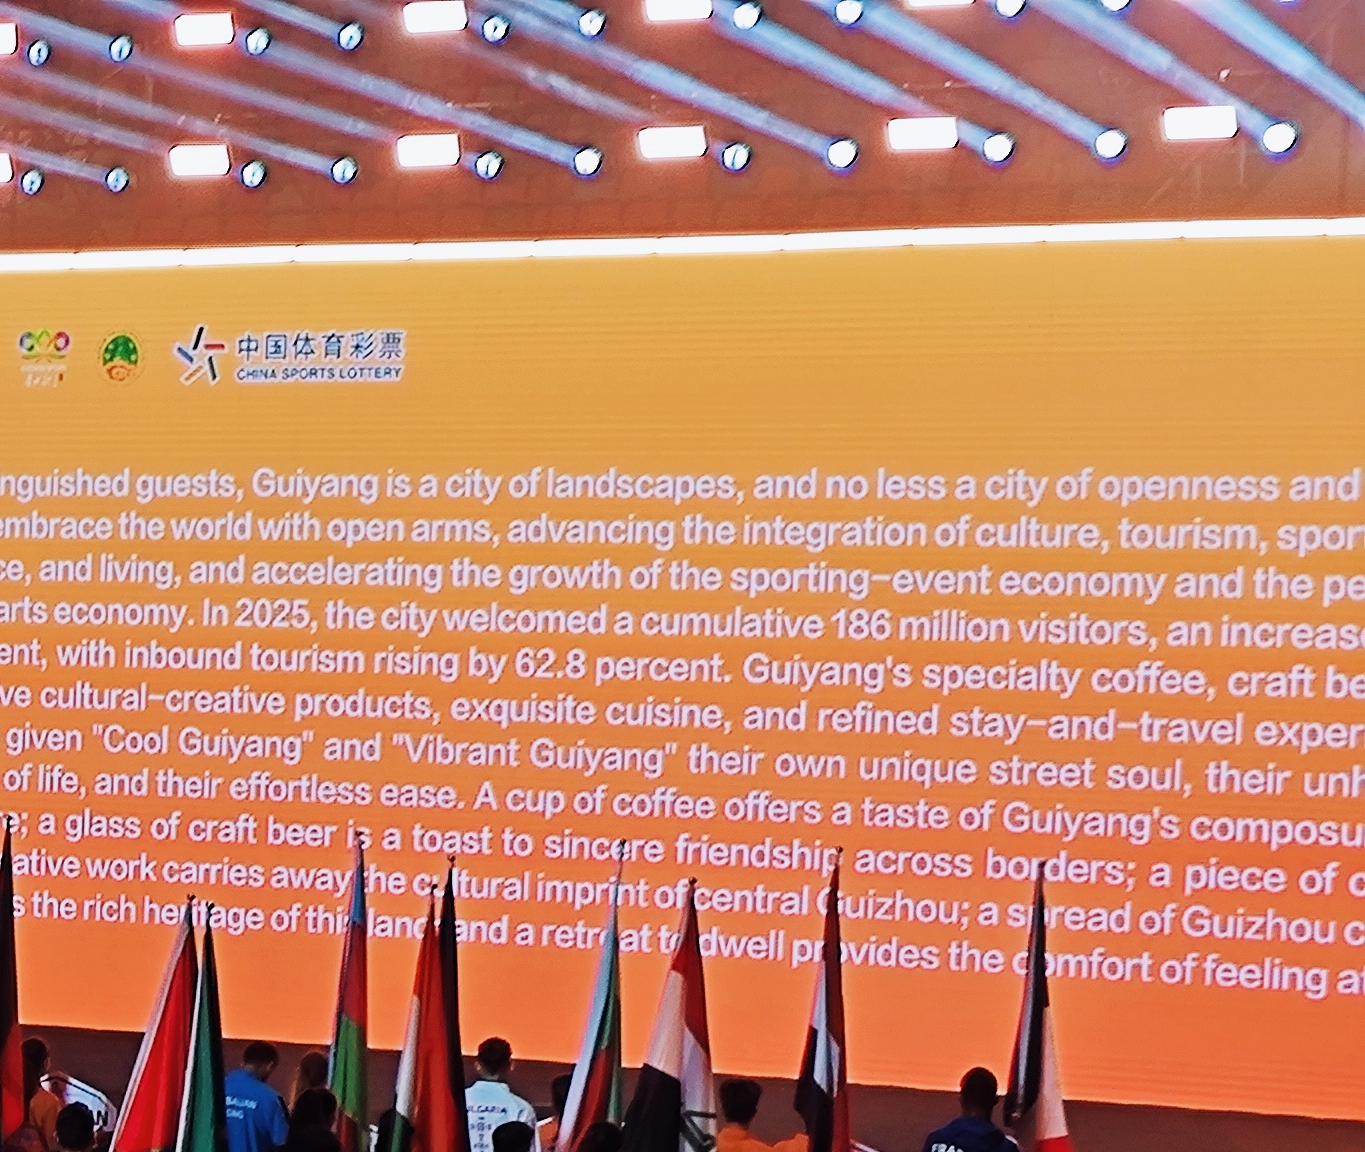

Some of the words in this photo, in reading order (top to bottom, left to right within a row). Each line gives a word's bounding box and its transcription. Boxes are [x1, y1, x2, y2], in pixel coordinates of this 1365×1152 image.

[236, 331, 404, 361] 中国体育彩票
[236, 367, 277, 381] CHINA
[281, 367, 336, 381] SPORTS
[339, 366, 403, 381] LOTTERY
[135, 469, 244, 505] guests,
[251, 467, 380, 505] Guiyang
[385, 468, 412, 499] is
[418, 474, 439, 499] a
[444, 468, 503, 505] city
[508, 466, 542, 499] of
[546, 467, 744, 506] landscapes,
[752, 467, 818, 500] and
[825, 474, 870, 500] no
[876, 467, 948, 501] less
[954, 474, 977, 501] a
[983, 468, 1049, 508] city
[1055, 466, 1094, 501] of
[1097, 475, 1281, 508] openness
[1288, 467, 1362, 502] and
[117, 510, 166, 541] the
[169, 511, 253, 541] world
[257, 511, 321, 541] with
[326, 518, 405, 548] open
[410, 519, 500, 548] arms,
[506, 512, 676, 552] advancing
[681, 513, 737, 545] the
[742, 515, 928, 553] integration
[933, 513, 971, 548] of
[974, 515, 1110, 554] culture,
[1117, 517, 1268, 556] tourism,
[1276, 524, 1365, 558] spor
[38, 553, 93, 583] and
[99, 553, 181, 590] living,
[188, 554, 245, 585] and
[251, 556, 444, 594] accelerating
[449, 557, 502, 588] the
[508, 558, 622, 595] growth
[629, 557, 664, 590] of
[668, 559, 723, 591] the
[998, 570, 1168, 605] economy
[1173, 565, 1245, 599] and
[1252, 566, 1315, 600] the
[52, 601, 194, 633] economy.
[202, 597, 229, 627] In
[234, 597, 318, 634] 2025,
[324, 599, 376, 630] the
[380, 601, 438, 638] city
[442, 601, 608, 635] welcomed
[613, 611, 634, 636] a
[640, 605, 825, 640] cumulative
[830, 607, 892, 641] 186
[898, 609, 1011, 643] million
[1017, 612, 1158, 652] visitors,
[1166, 620, 1213, 647] an
[1220, 615, 1365, 651] increas
[56, 638, 116, 668] with
[124, 639, 242, 671] inbound
[249, 642, 365, 674] tourism
[373, 645, 460, 683] rising
[468, 646, 508, 684] by
[515, 647, 586, 679] 62.8
[595, 653, 732, 687] percent.
[742, 652, 913, 694] Guiyang's
[922, 658, 1082, 699] specialty
[1090, 660, 1216, 702] coffee,
[1227, 664, 1316, 698] craft
[294, 688, 440, 726] products,
[450, 693, 597, 729] exquisite
[605, 695, 732, 735] cuisine,
[742, 699, 808, 732] and
[817, 700, 940, 736] refined
[5, 721, 82, 756] given
[323, 732, 382, 762] and
[687, 742, 765, 775] their
[774, 753, 846, 779] own
[859, 750, 977, 789] unique
[988, 755, 1096, 789] street
[1106, 758, 1192, 798] soul,
[1204, 760, 1292, 795] their
